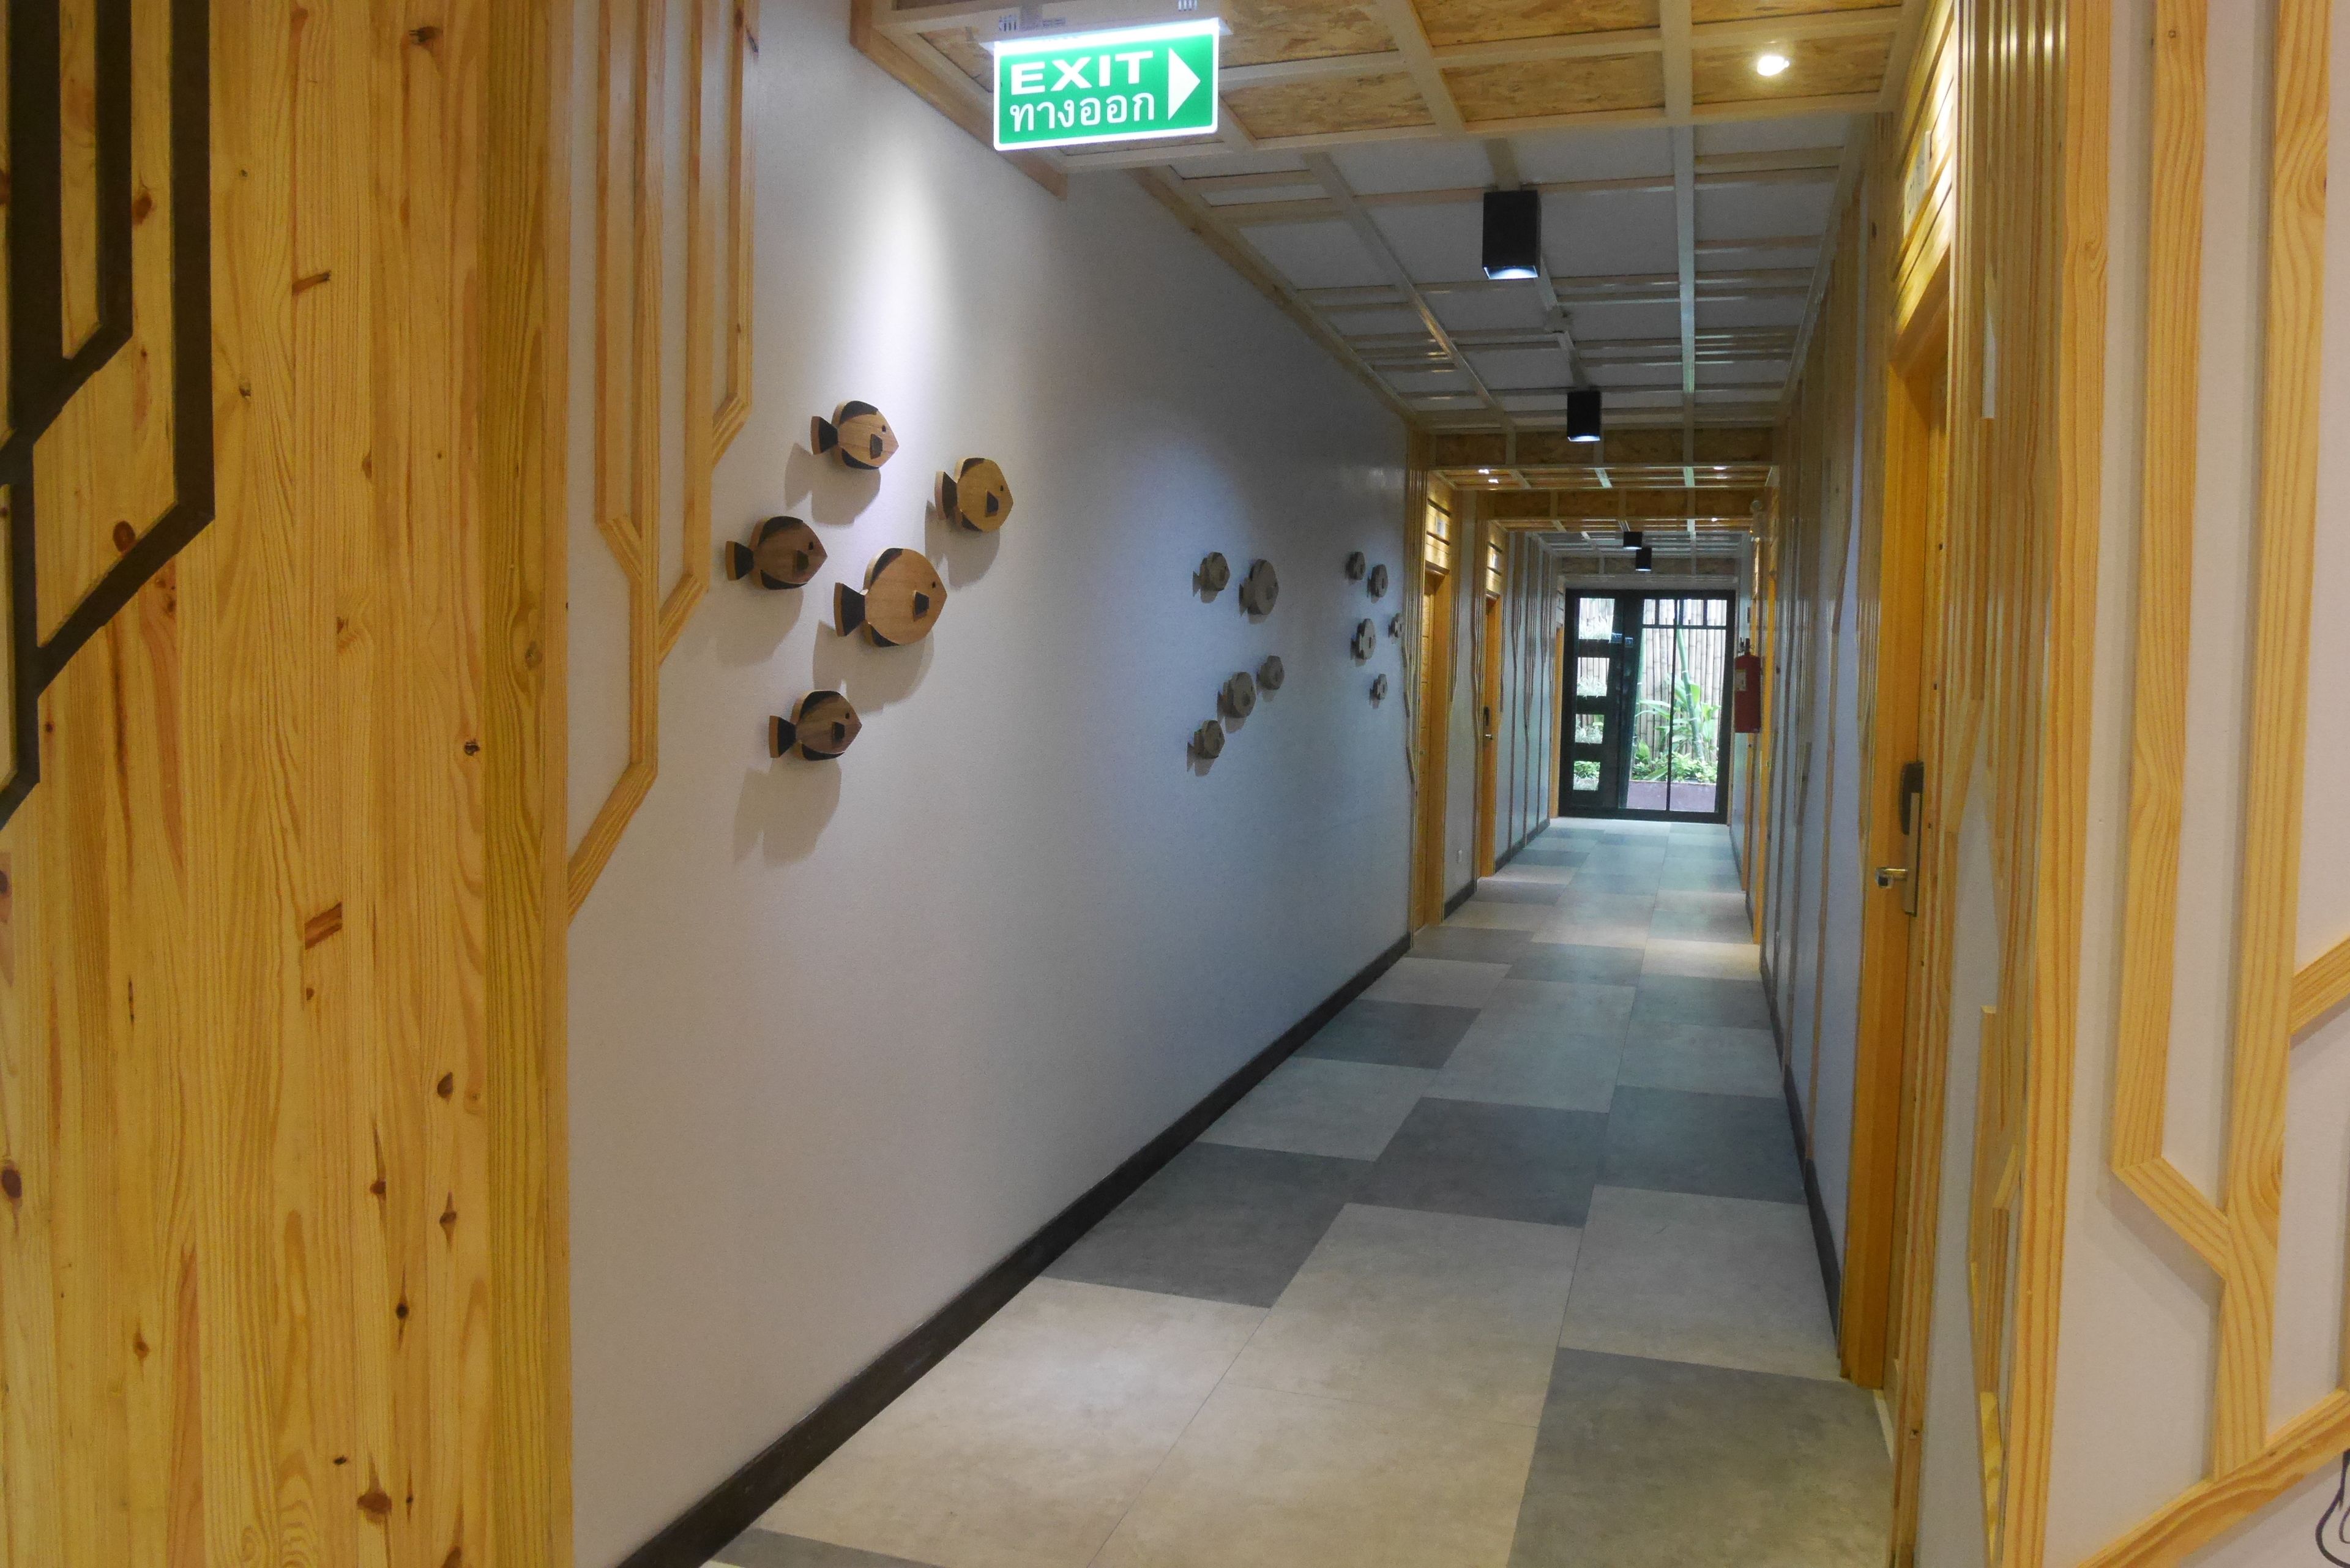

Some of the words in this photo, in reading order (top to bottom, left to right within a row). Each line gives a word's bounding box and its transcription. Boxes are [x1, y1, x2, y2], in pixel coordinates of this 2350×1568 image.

[1011, 51, 1154, 95] EXIT
[1010, 92, 1155, 132] ทางออก
